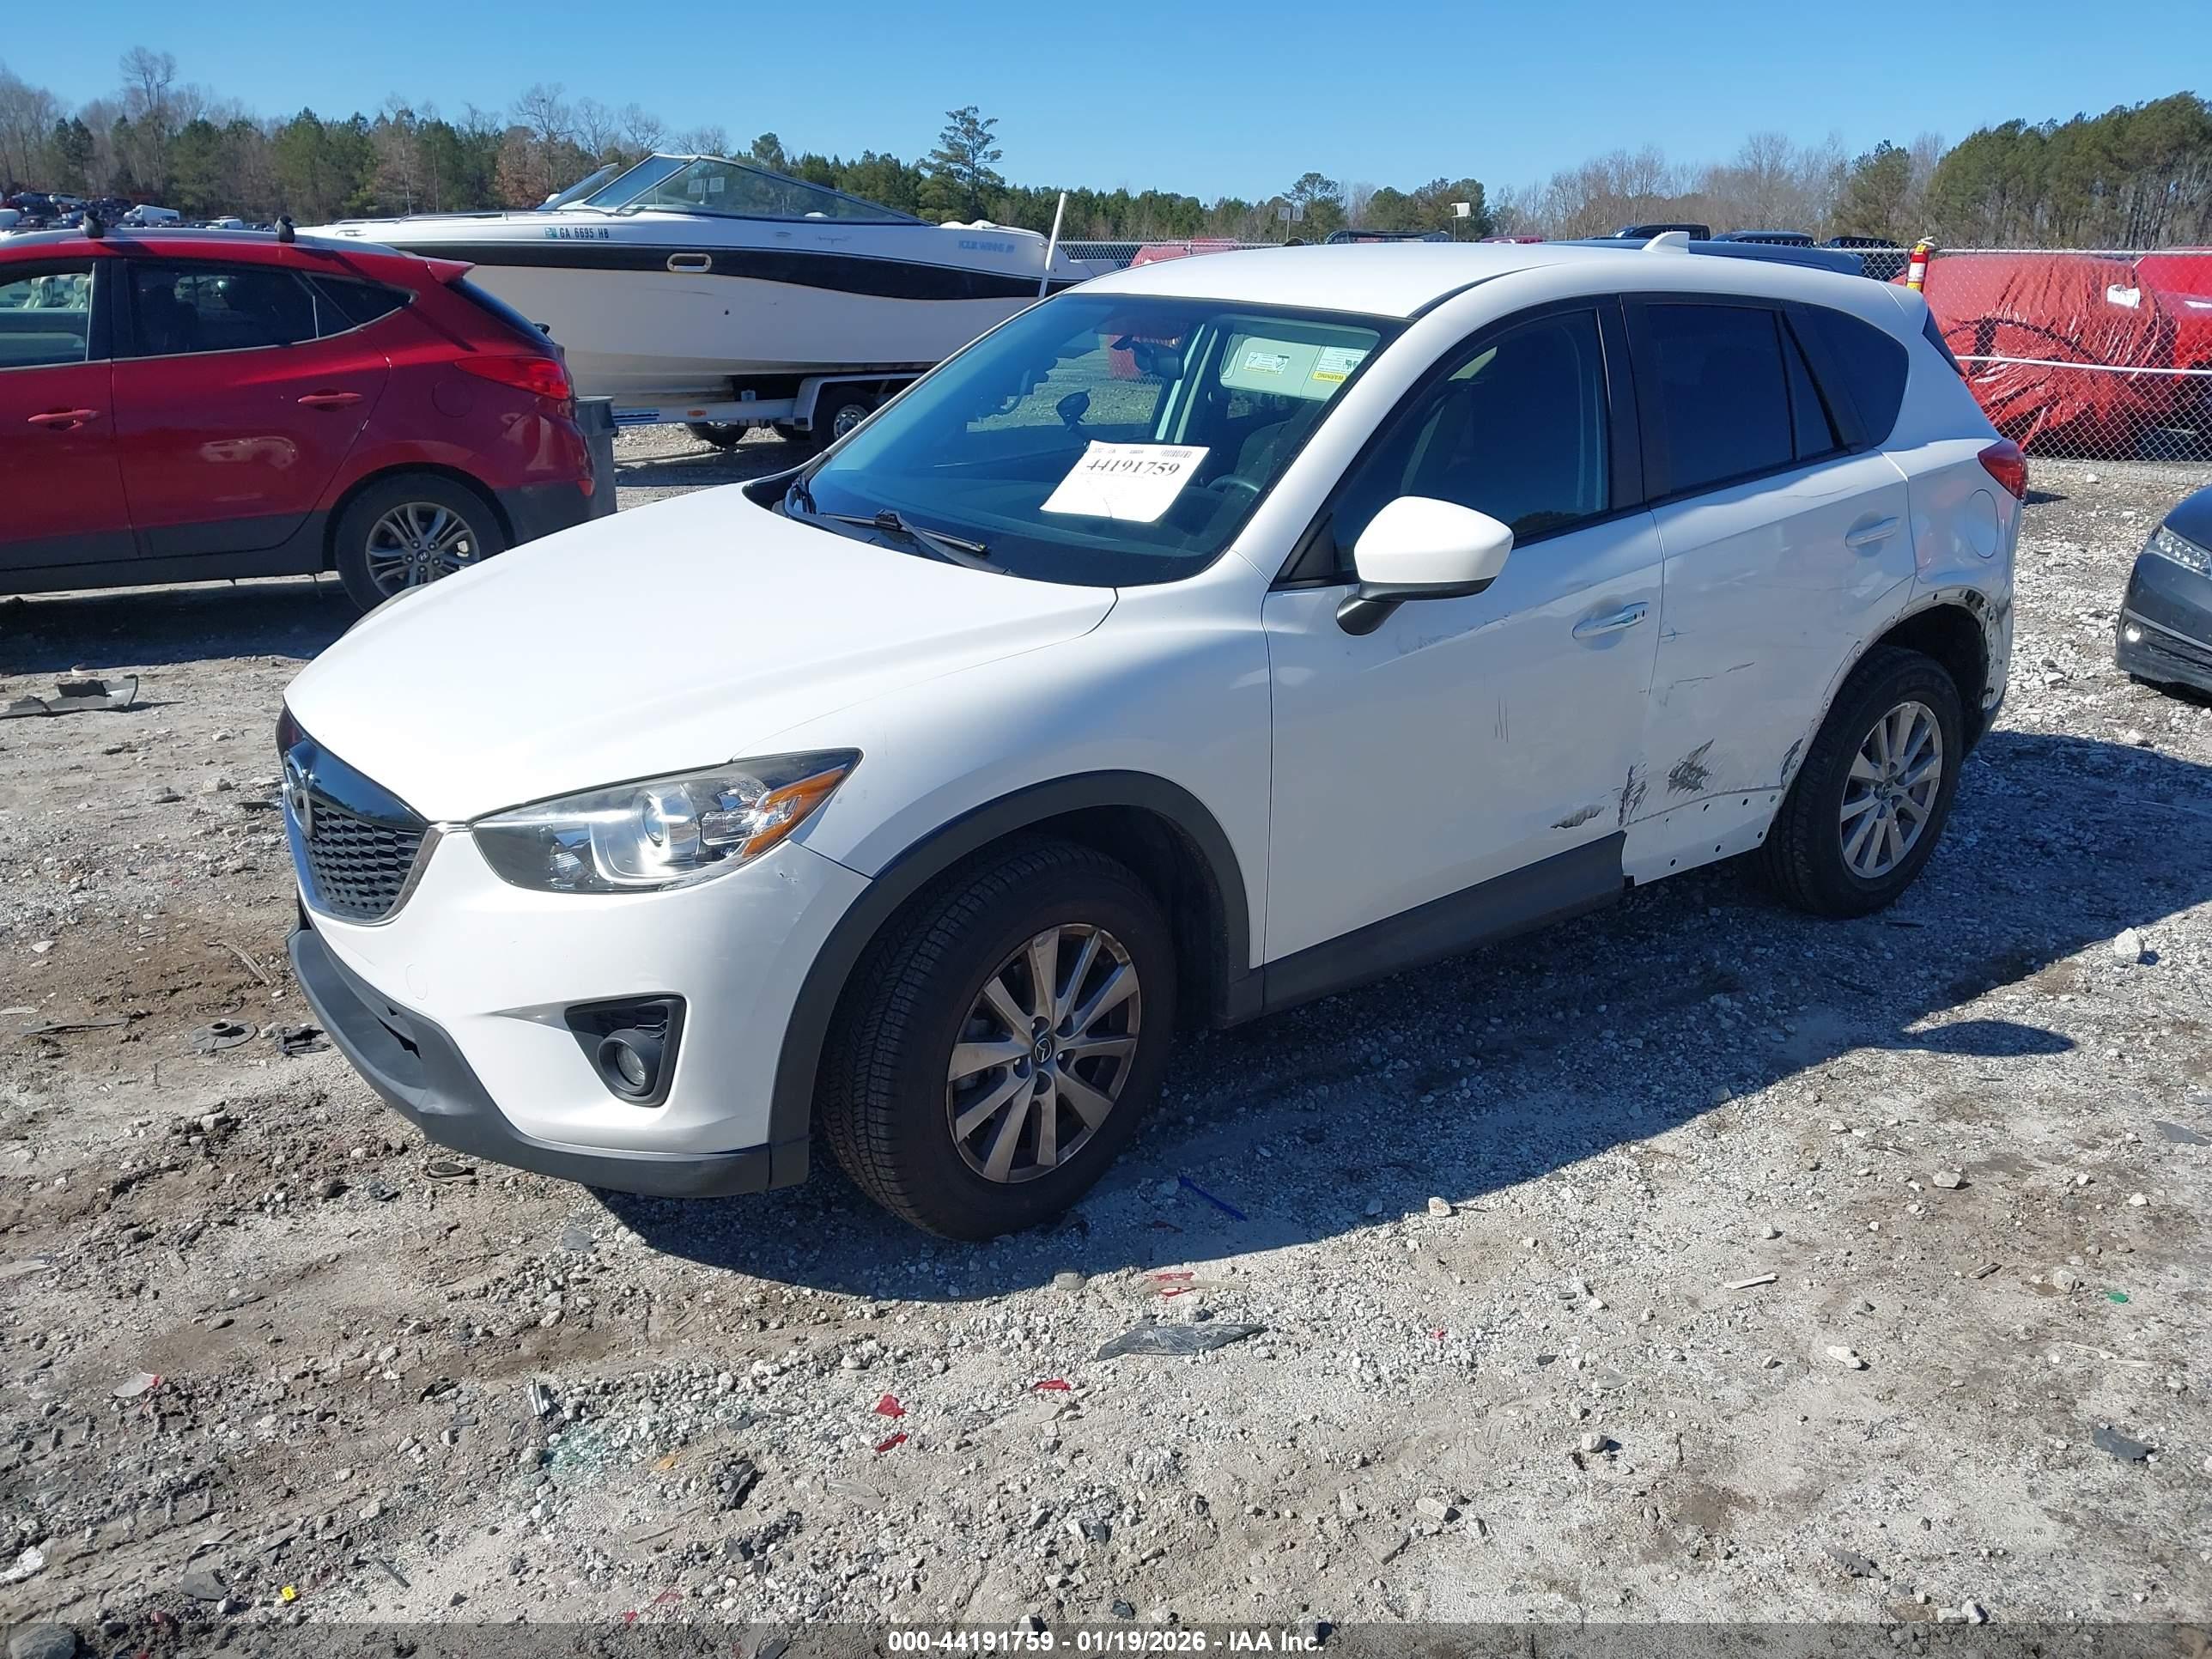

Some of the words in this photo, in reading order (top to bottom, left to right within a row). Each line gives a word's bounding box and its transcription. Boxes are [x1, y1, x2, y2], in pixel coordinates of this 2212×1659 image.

[560, 227, 570, 238] GA
[574, 227, 594, 238] 6695
[1086, 459, 1181, 477] 44191759
